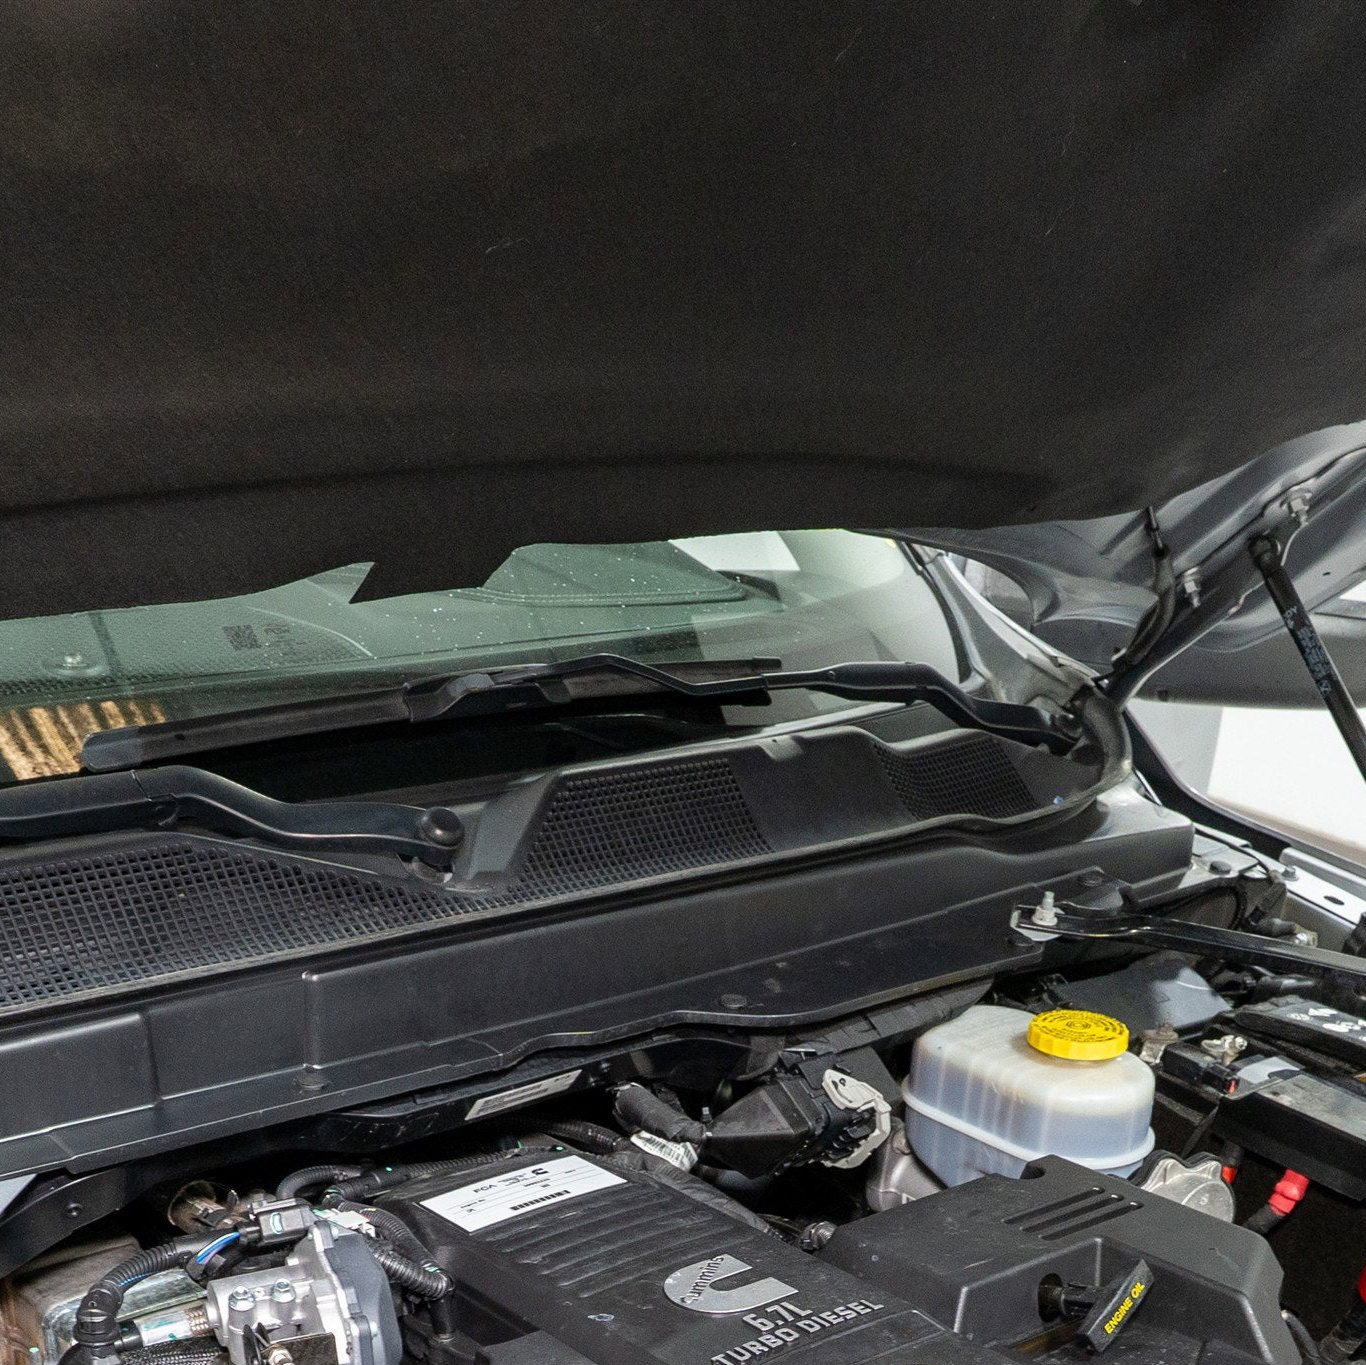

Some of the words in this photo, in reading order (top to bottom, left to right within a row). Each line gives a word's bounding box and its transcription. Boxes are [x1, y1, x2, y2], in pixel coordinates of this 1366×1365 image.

[679, 1255, 726, 1305] Cummins
[742, 1301, 813, 1332] 6.7L
[796, 1299, 885, 1333] DIESEL
[1104, 1297, 1133, 1334] ENGINE
[1131, 1282, 1145, 1298] OIL
